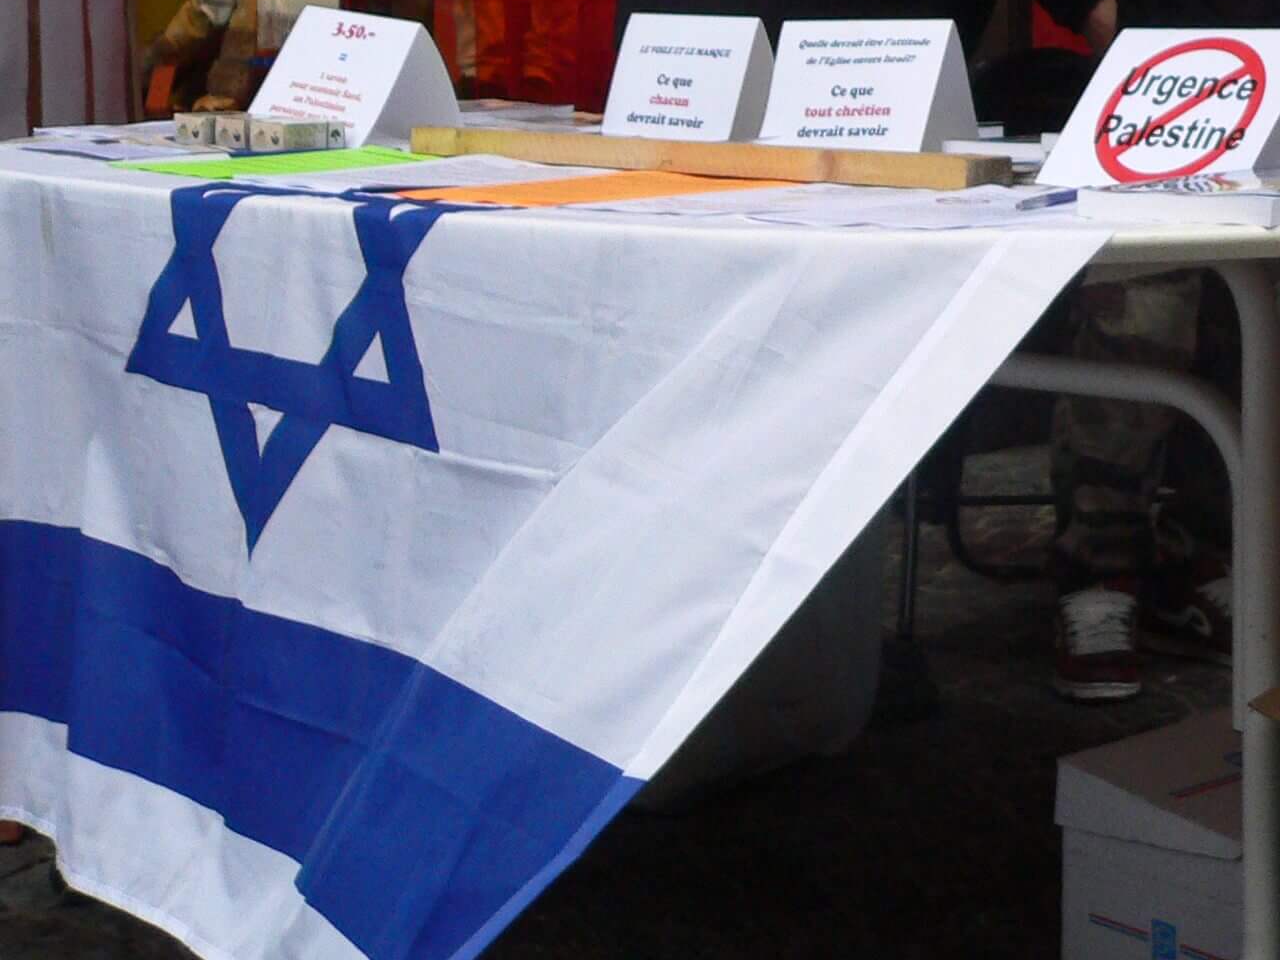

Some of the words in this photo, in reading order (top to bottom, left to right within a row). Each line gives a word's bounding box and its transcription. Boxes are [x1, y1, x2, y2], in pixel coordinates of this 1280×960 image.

[657, 73, 670, 85] Ce
[672, 77, 693, 88] que
[1121, 66, 1258, 106] Urgence
[831, 85, 846, 97] Ce
[850, 86, 874, 99] que
[649, 94, 689, 107] chacun
[805, 107, 832, 117] tout
[836, 105, 891, 117] chrétien
[627, 112, 666, 125] devrait
[668, 117, 703, 128] savoir
[798, 125, 844, 138] devrait
[848, 124, 888, 137] savoir
[1094, 113, 1246, 151] Palestine
